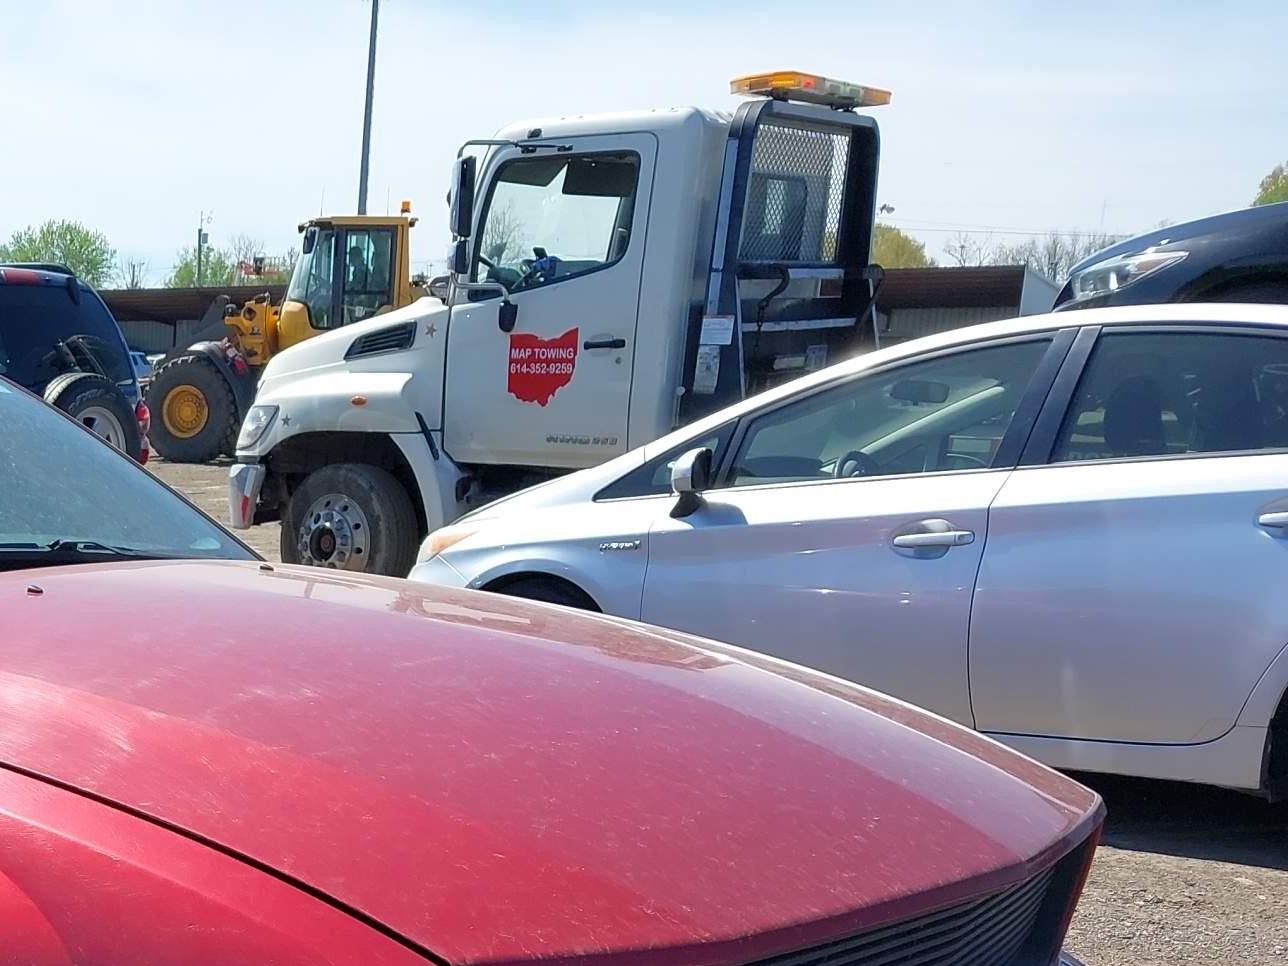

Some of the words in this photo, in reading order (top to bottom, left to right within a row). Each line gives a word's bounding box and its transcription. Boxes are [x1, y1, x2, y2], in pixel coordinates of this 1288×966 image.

[511, 347, 532, 359] MAP
[534, 347, 574, 359] TOWING
[510, 362, 573, 374] 614-352-9259
